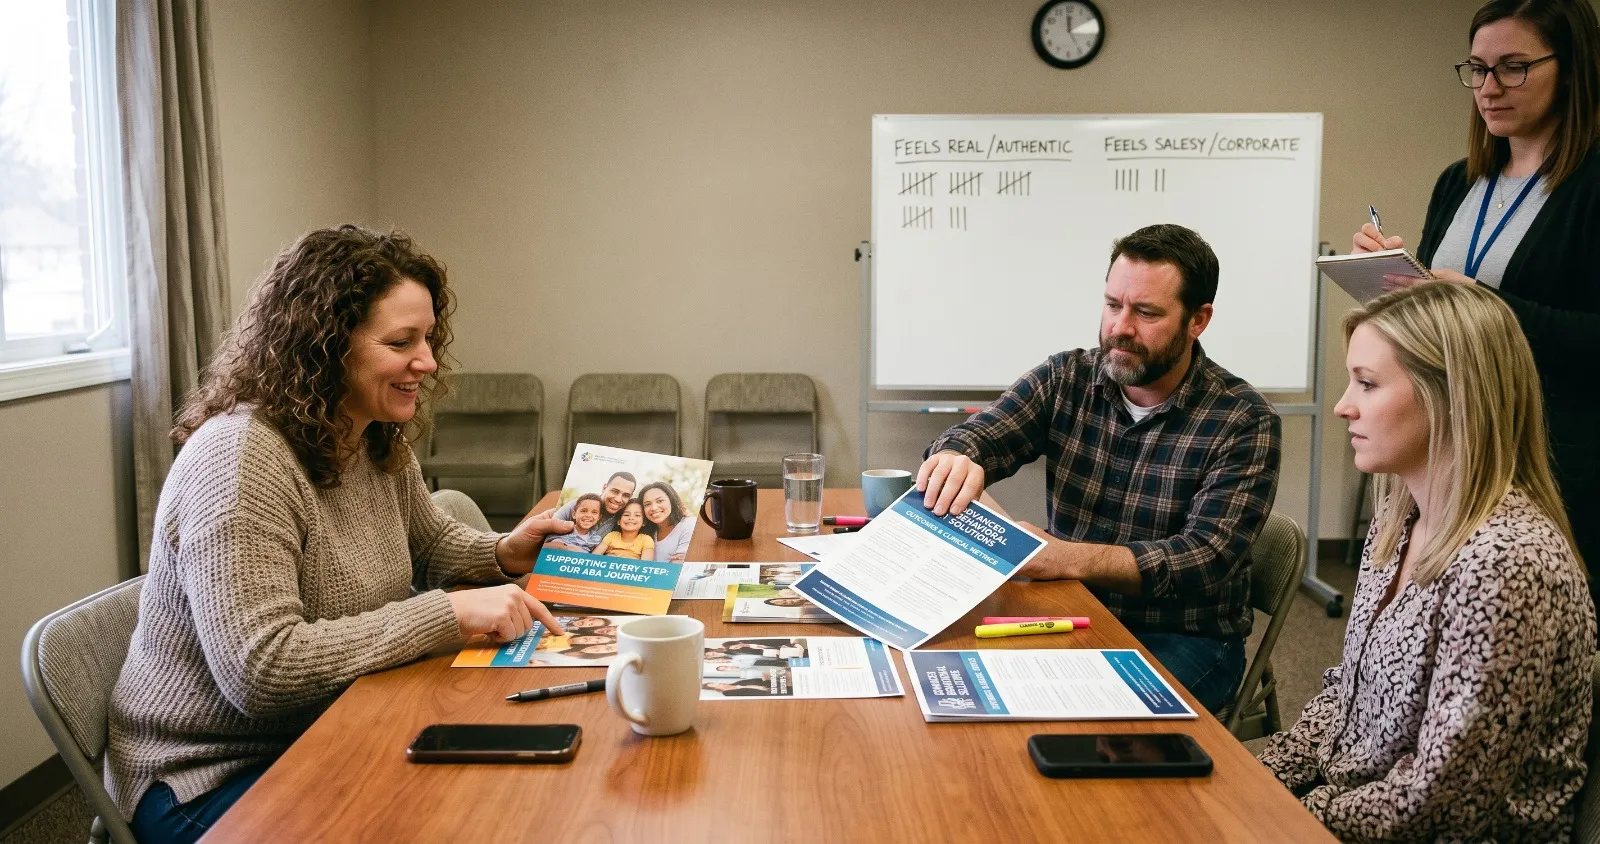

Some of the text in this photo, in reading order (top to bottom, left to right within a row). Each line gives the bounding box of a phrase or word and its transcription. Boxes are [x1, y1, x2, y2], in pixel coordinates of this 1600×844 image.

[895, 134, 1074, 159] FEELS REAL/AUTHENTIC
[1104, 132, 1300, 155] FEELS SALESY/CORPORATE
[942, 532, 969, 550] CLINICAL
[949, 518, 996, 547] SOLUTIONS
[545, 554, 670, 576] SUPPORTING EVERY STEP:
[559, 565, 651, 583] OUR ABA JOURNEY
